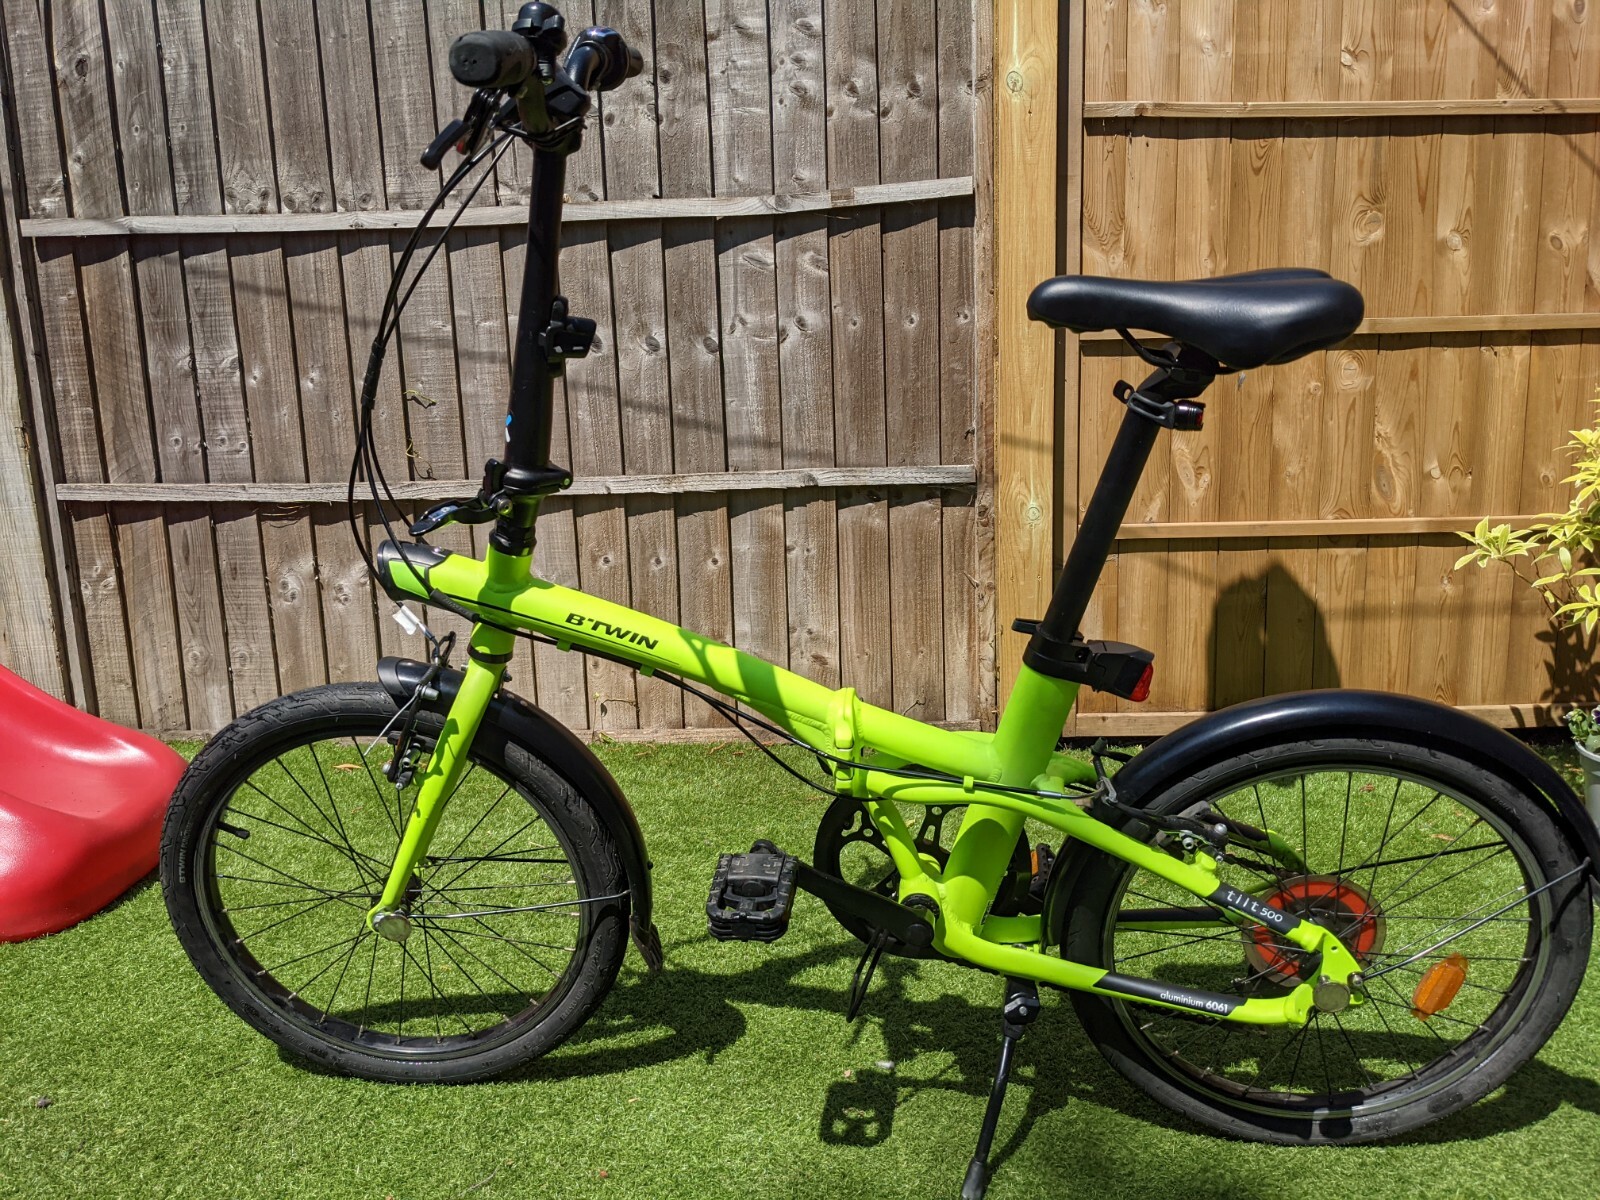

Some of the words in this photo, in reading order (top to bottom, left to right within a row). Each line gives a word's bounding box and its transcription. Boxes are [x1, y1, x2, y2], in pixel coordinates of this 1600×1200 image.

[1226, 890, 1260, 912] tilt
[1259, 907, 1283, 922] 500
[1160, 990, 1204, 1008] aluminium
[1205, 1000, 1229, 1013] 6061
